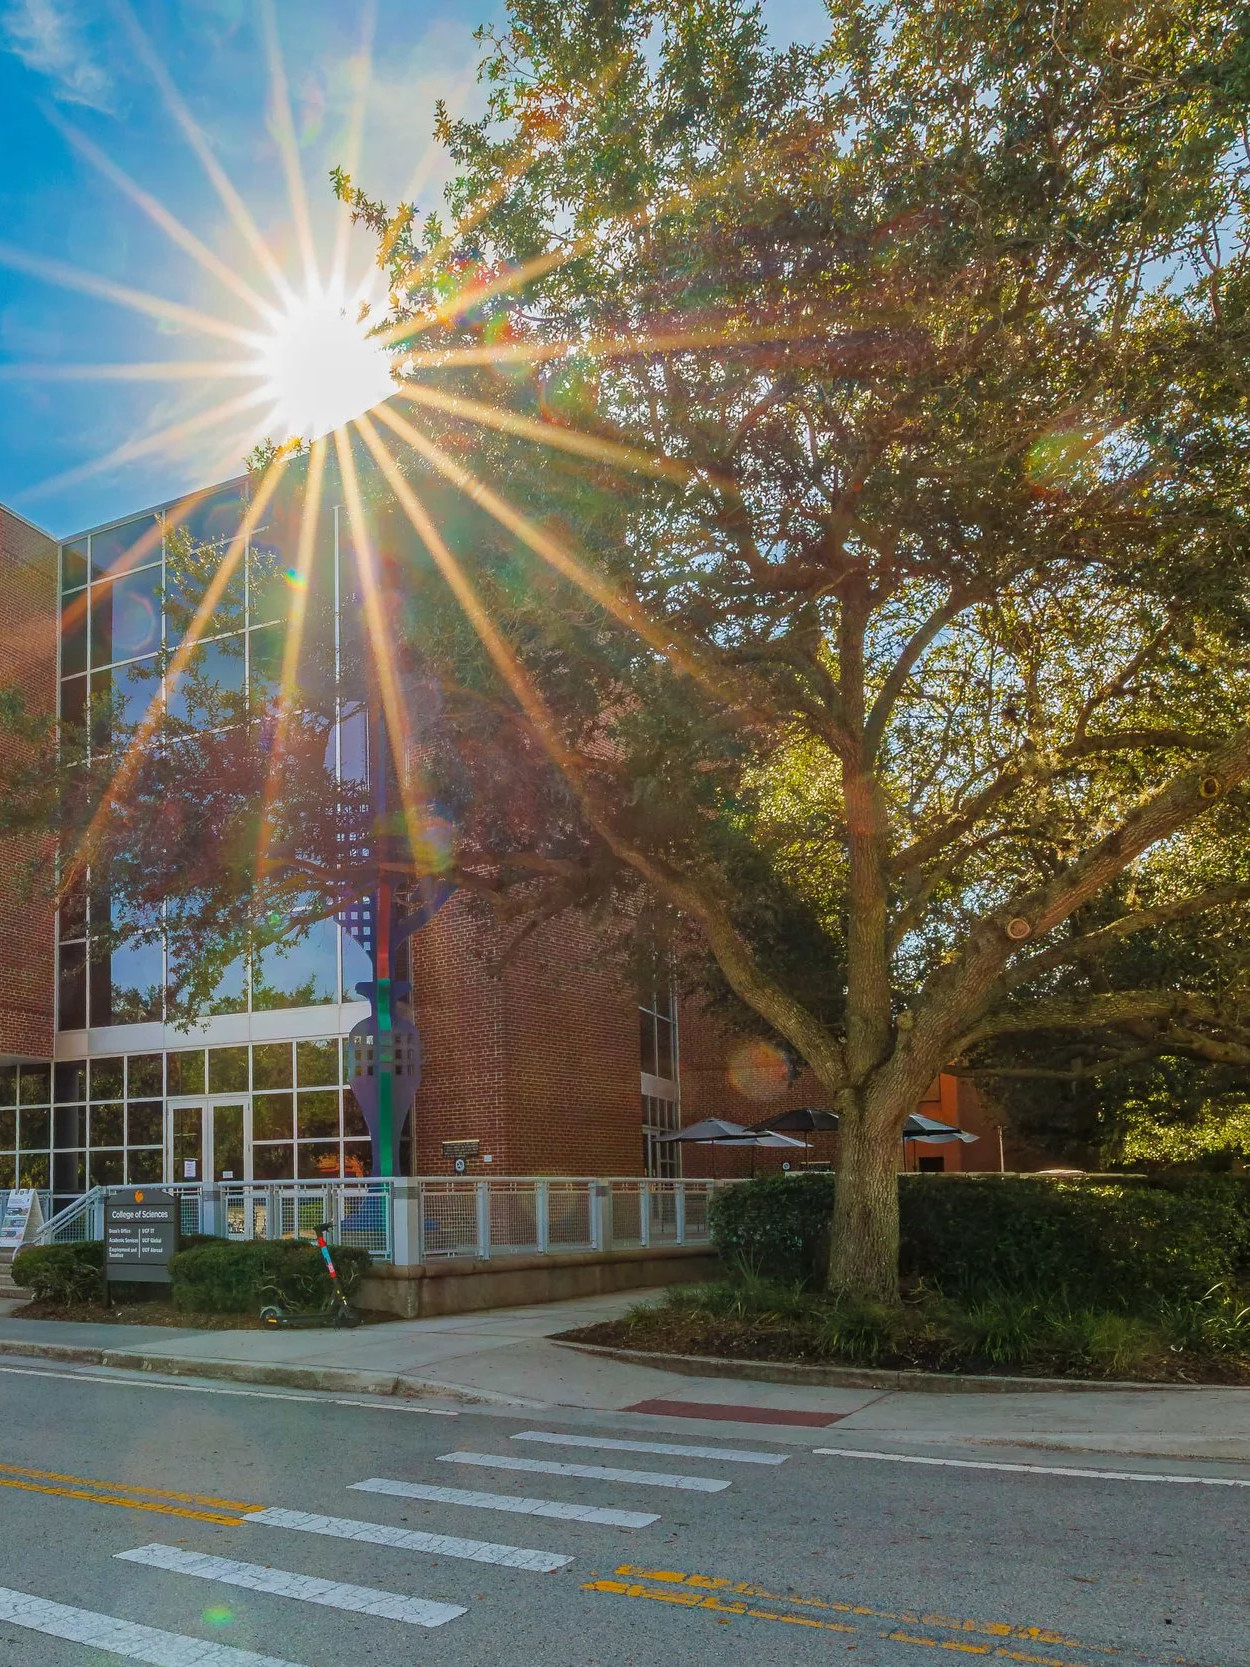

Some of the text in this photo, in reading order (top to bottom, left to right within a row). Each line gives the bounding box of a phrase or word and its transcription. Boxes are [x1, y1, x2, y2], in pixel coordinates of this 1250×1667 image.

[111, 1210, 169, 1219] College of Sciences
